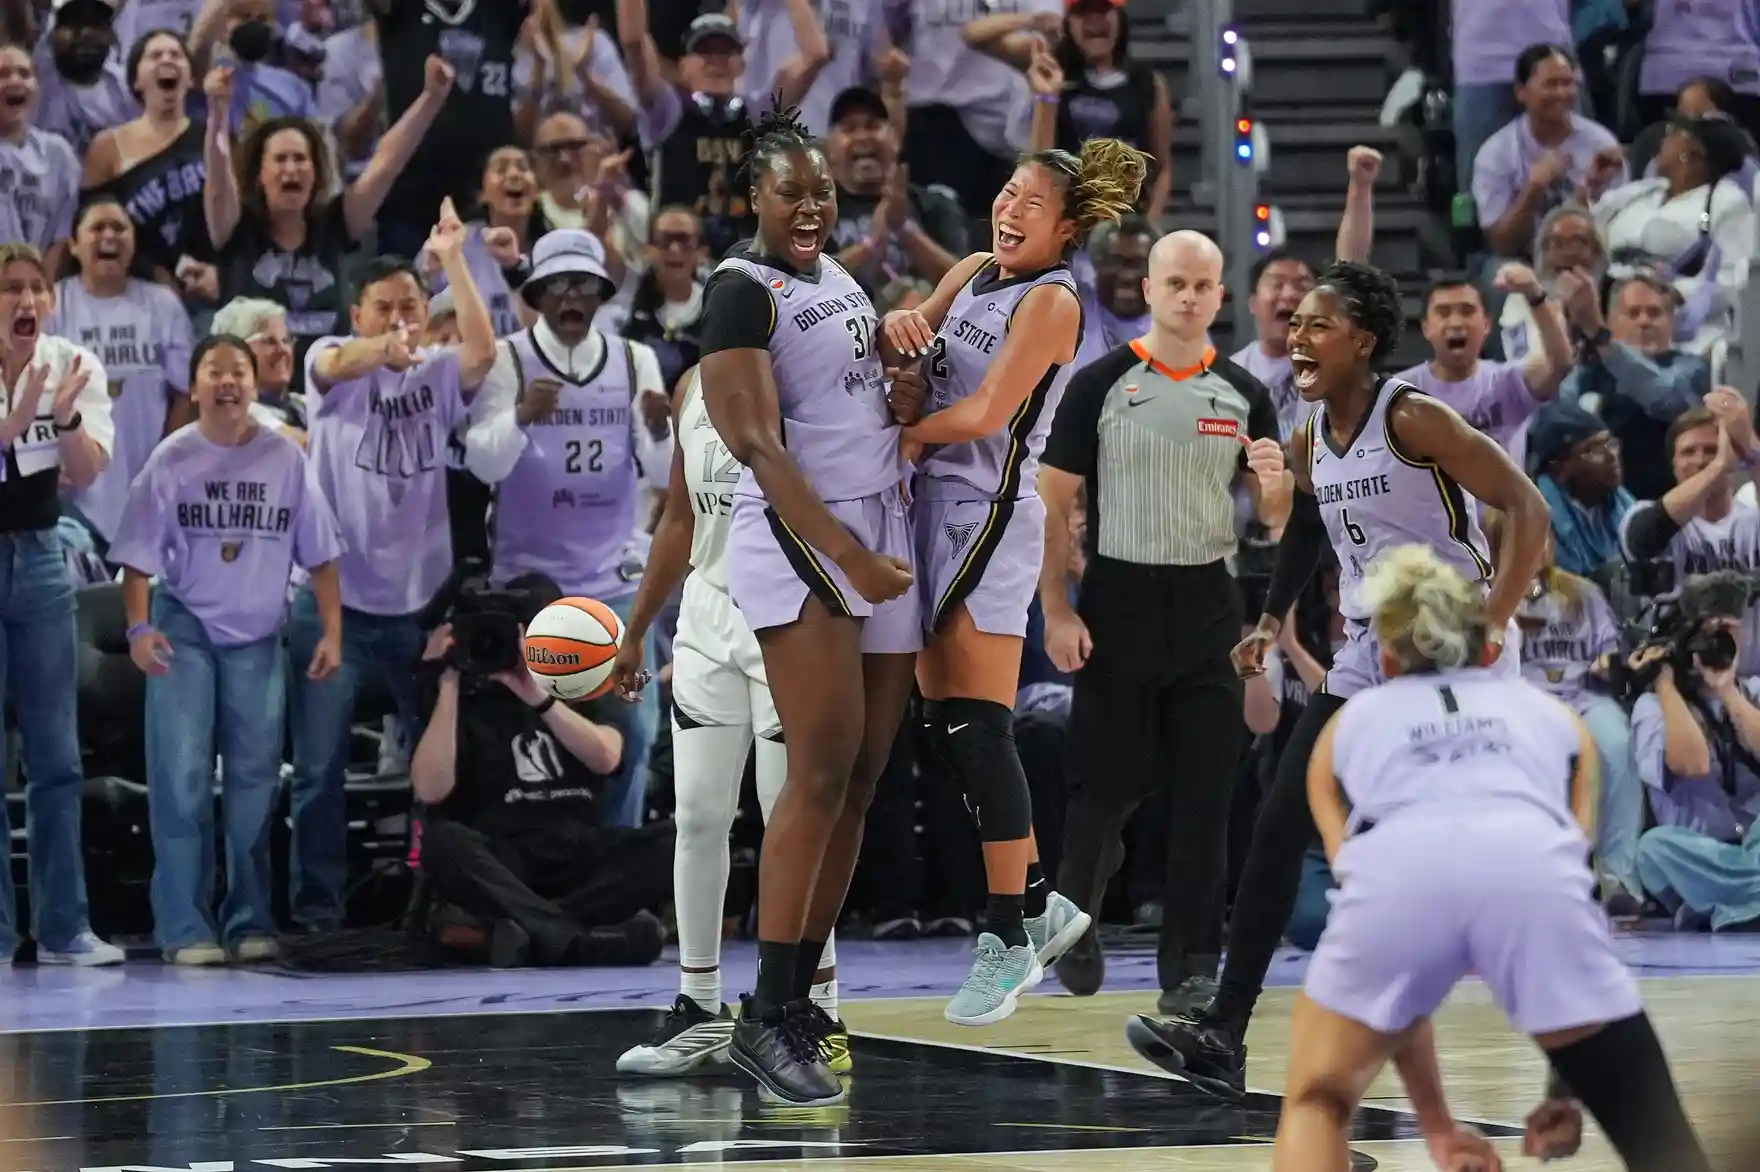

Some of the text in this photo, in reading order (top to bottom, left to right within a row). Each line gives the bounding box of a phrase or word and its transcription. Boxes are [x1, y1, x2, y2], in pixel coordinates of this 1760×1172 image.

[793, 291, 869, 332] GOLDEN STA
[844, 314, 871, 361] 31
[953, 320, 997, 354] STATE
[542, 408, 582, 426] LDEN
[1198, 420, 1237, 434] Emirates
[565, 440, 604, 474] 22
[703, 440, 740, 483] 12
[205, 481, 267, 503] WE ARE
[1317, 474, 1391, 505] LDEN STATE
[177, 502, 290, 533] BALLHALLA
[1341, 507, 1367, 546] 6
[526, 645, 580, 665] Wilson
